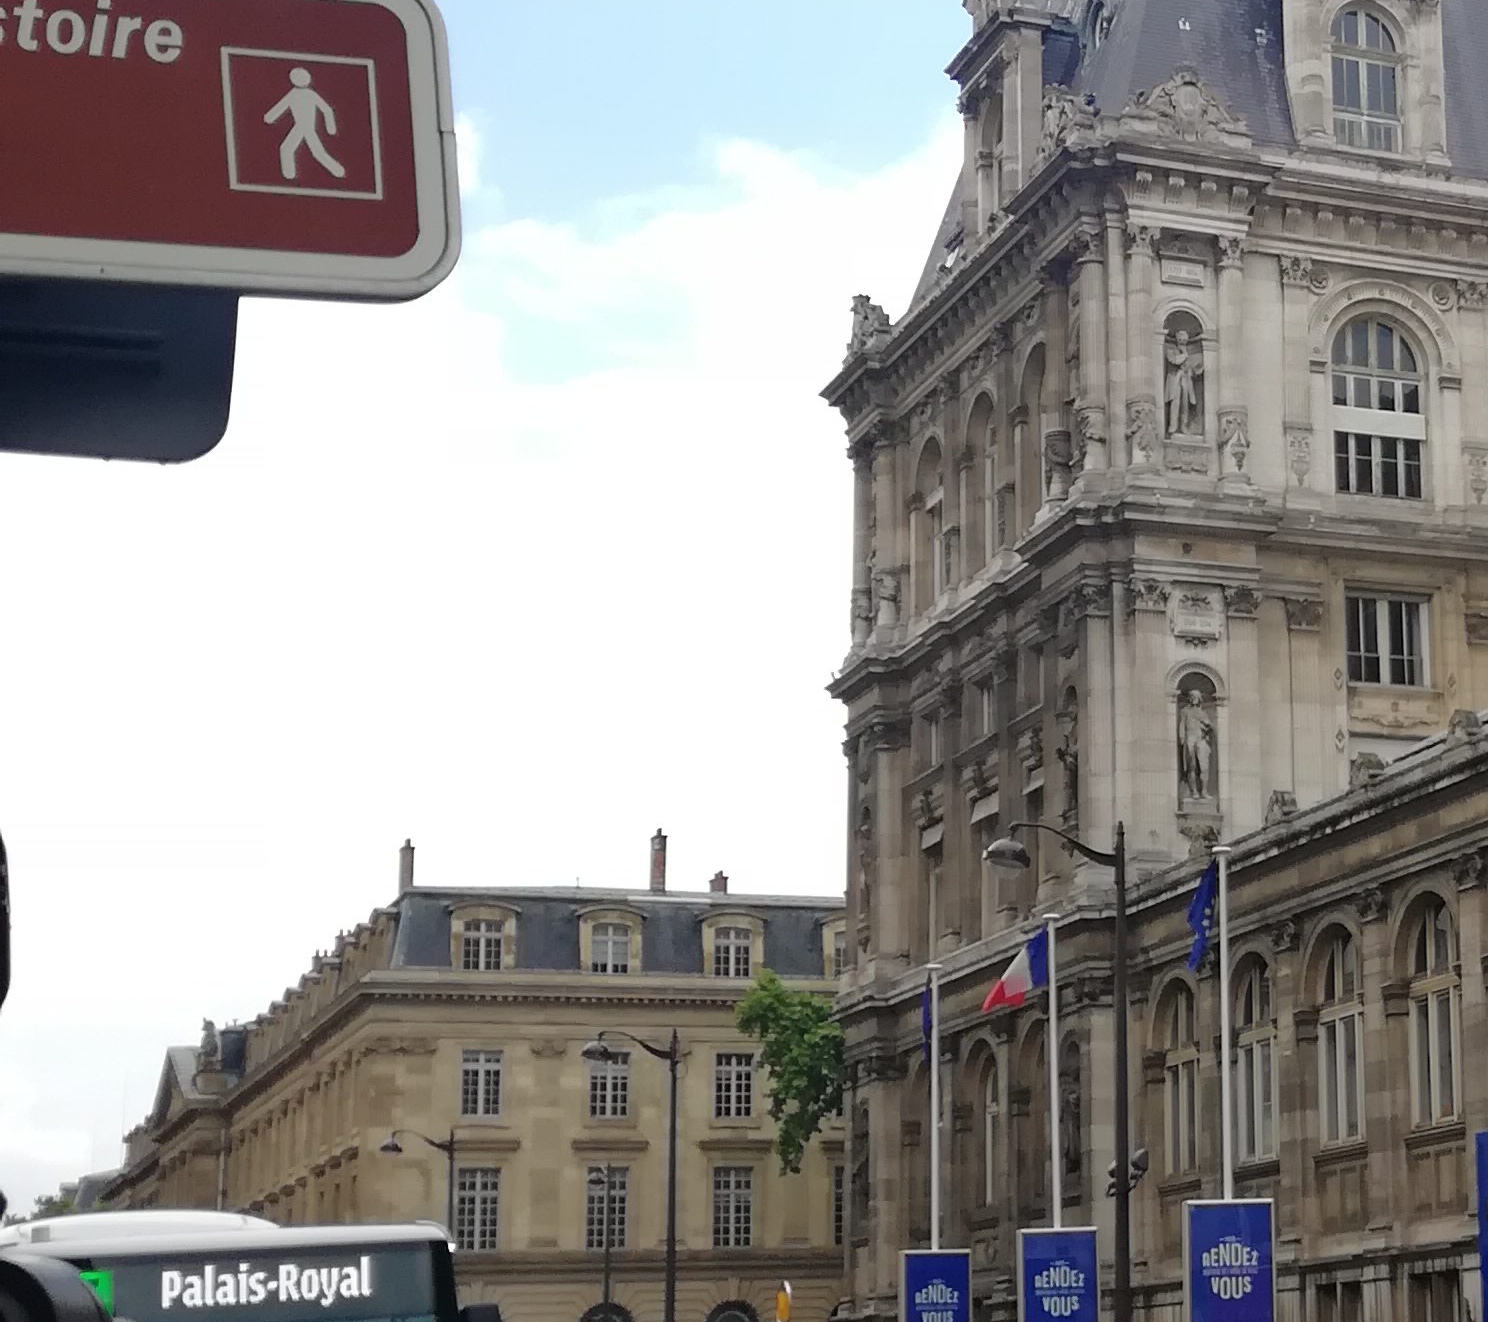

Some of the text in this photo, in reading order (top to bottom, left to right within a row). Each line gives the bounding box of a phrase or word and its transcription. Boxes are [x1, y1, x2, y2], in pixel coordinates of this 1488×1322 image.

[161, 1255, 373, 1310] Palais-Royal
[1210, 1275, 1252, 1300] VOUS
[1042, 1295, 1079, 1317] VOUS
